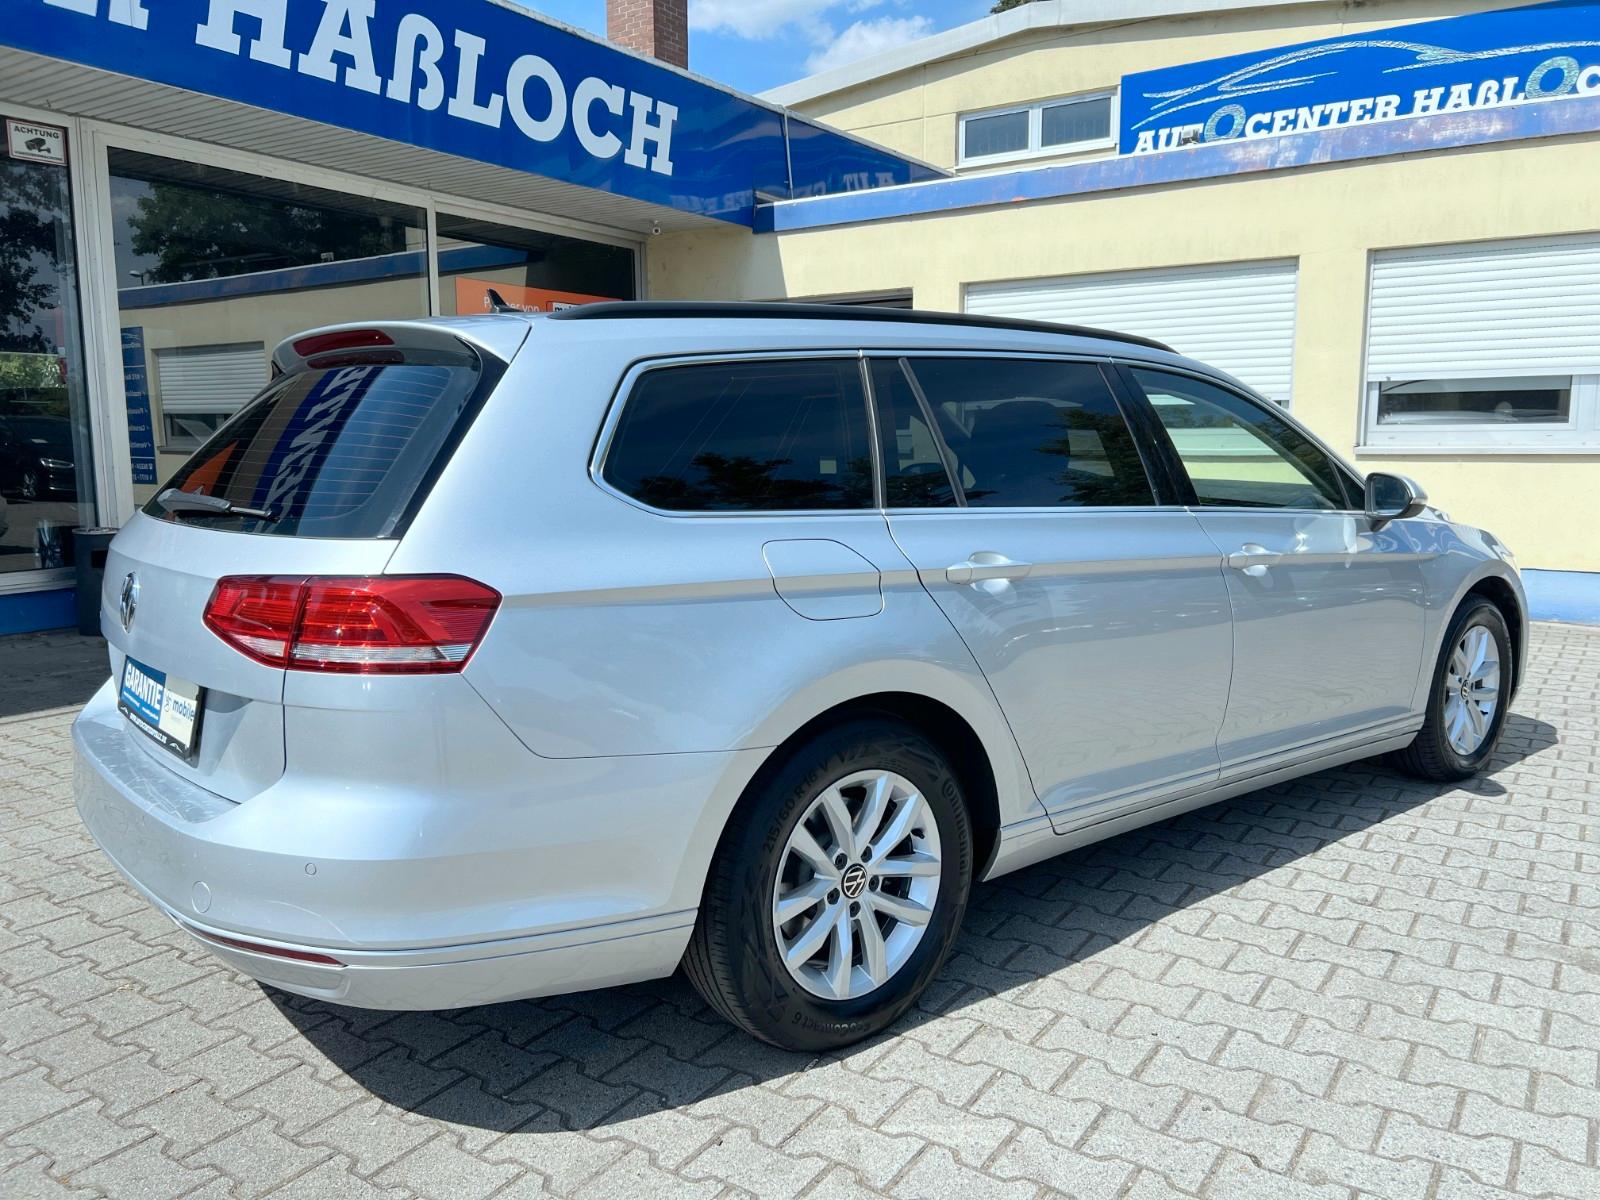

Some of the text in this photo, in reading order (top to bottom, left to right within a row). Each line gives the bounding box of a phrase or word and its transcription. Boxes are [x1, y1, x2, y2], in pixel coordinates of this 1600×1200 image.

[14, 125, 60, 139] ACHTUNG
[124, 662, 164, 710] GARANTIE
[172, 697, 195, 723] mobile
